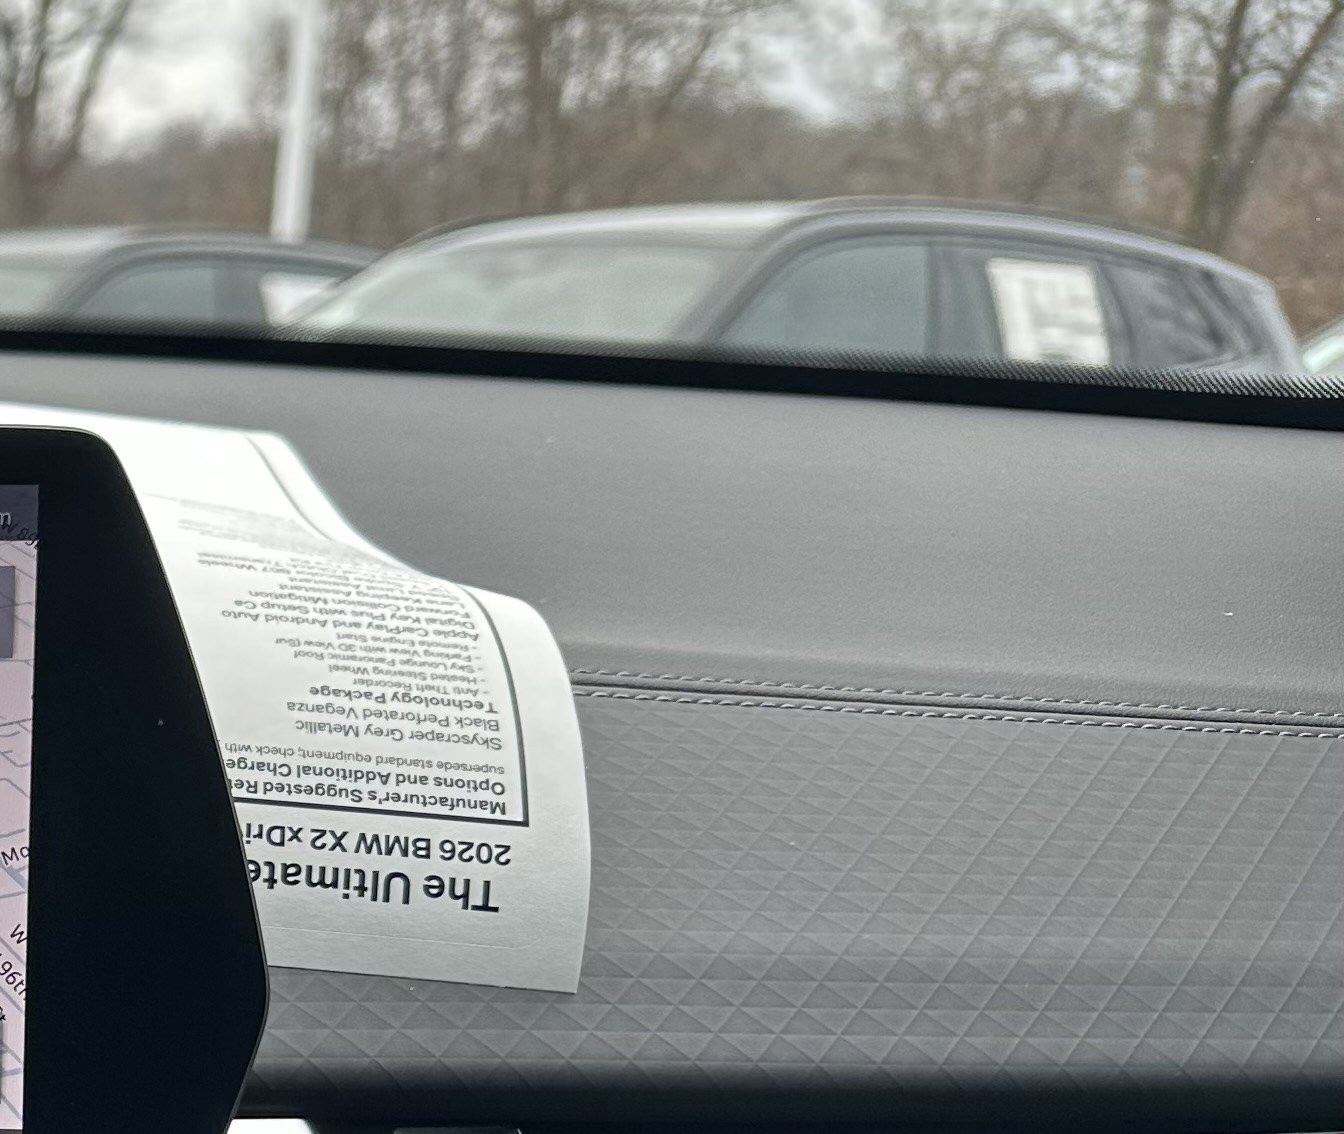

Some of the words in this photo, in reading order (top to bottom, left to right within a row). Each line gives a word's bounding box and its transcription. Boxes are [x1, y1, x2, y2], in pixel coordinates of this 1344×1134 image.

[309, 685, 387, 705] Package
[392, 692, 499, 714] Technology
[287, 701, 359, 720] Veganza
[363, 708, 450, 728] Perforated
[295, 720, 360, 737] Metallic
[364, 725, 404, 742] Grey
[454, 717, 500, 732] Black
[224, 742, 253, 752] with
[408, 727, 503, 750] Skyscraper
[255, 744, 295, 757] check
[375, 756, 434, 769] standard
[435, 762, 505, 775] supersede
[297, 765, 391, 785] Additional
[395, 773, 429, 786] and
[263, 782, 363, 803] Suggested
[434, 777, 505, 796] Options
[368, 788, 506, 816] Manufacturer's
[310, 828, 349, 852] X2
[354, 832, 431, 859] BMW
[439, 839, 512, 866] 2026
[248, 859, 411, 905] Ultimate
[422, 874, 499, 913] The
